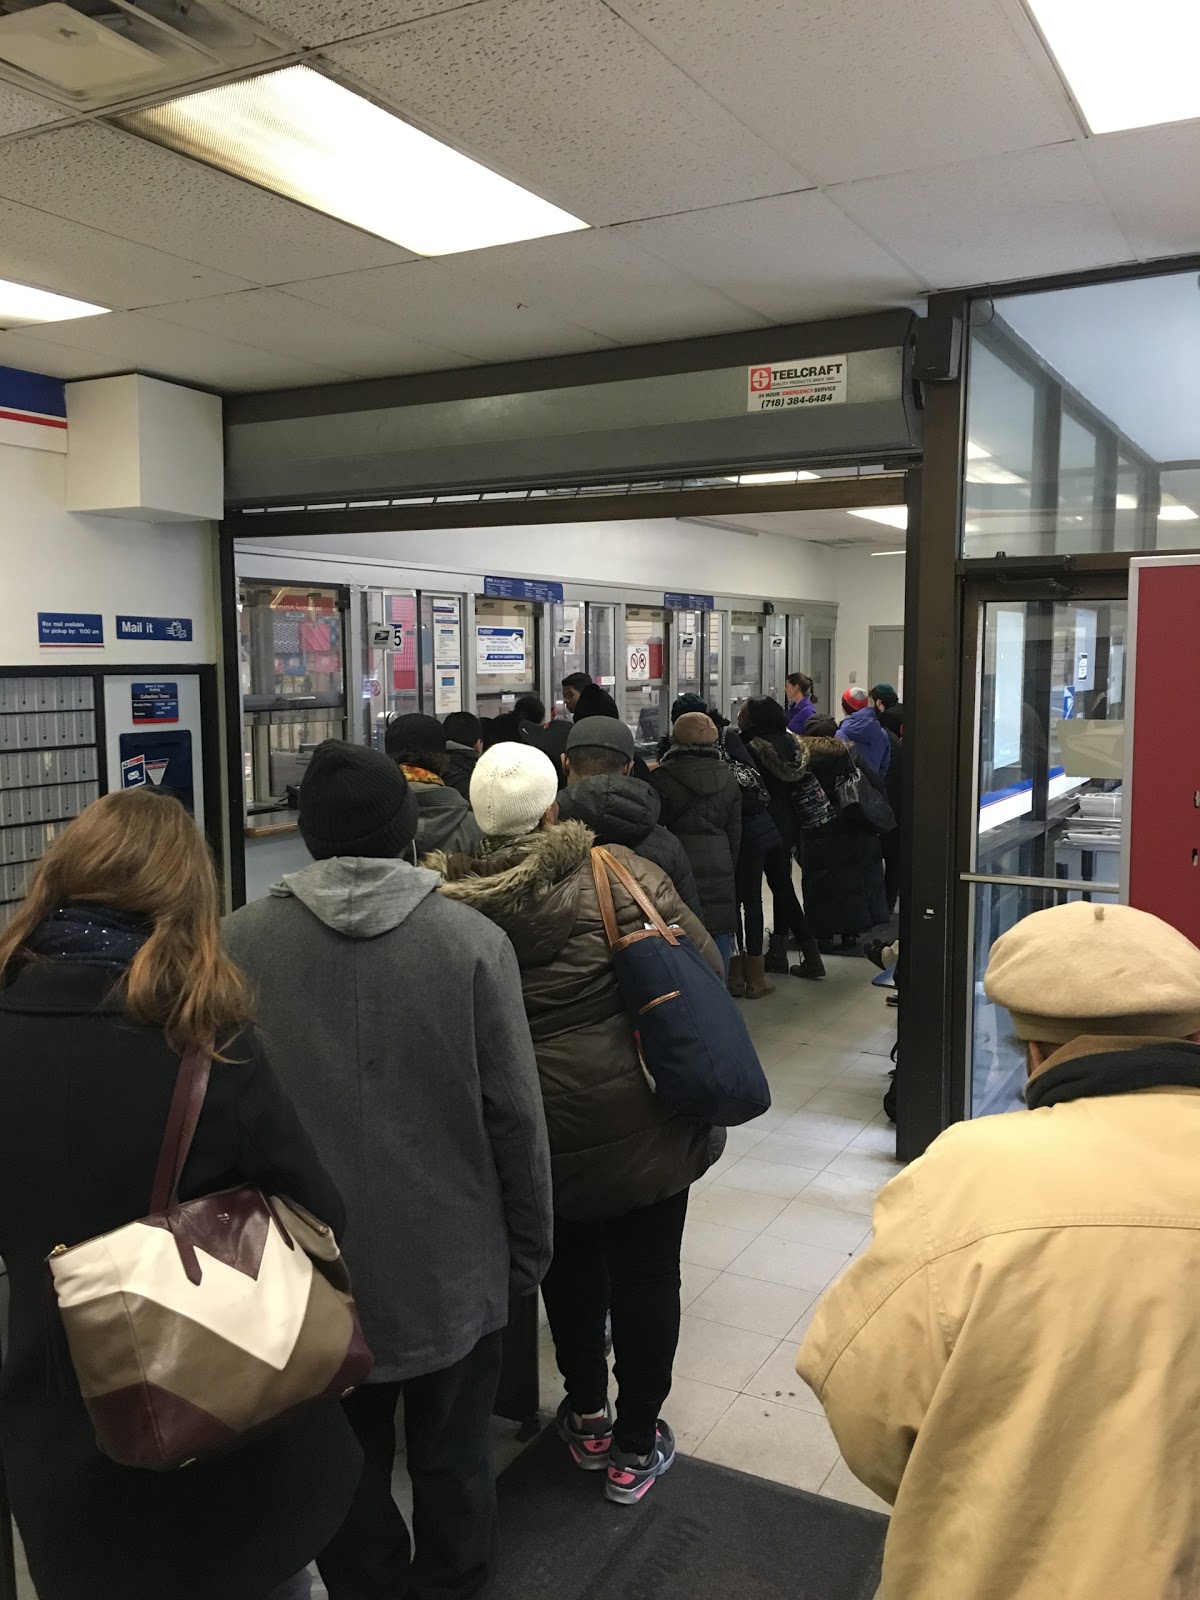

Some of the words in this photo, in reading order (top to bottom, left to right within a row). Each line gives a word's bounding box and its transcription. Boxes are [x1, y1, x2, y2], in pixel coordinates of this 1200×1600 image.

[761, 398, 785, 409] (718)
[787, 394, 833, 406] 384-6484
[122, 621, 143, 633] Mail
[146, 622, 154, 634] it
[394, 630, 402, 647] 5
